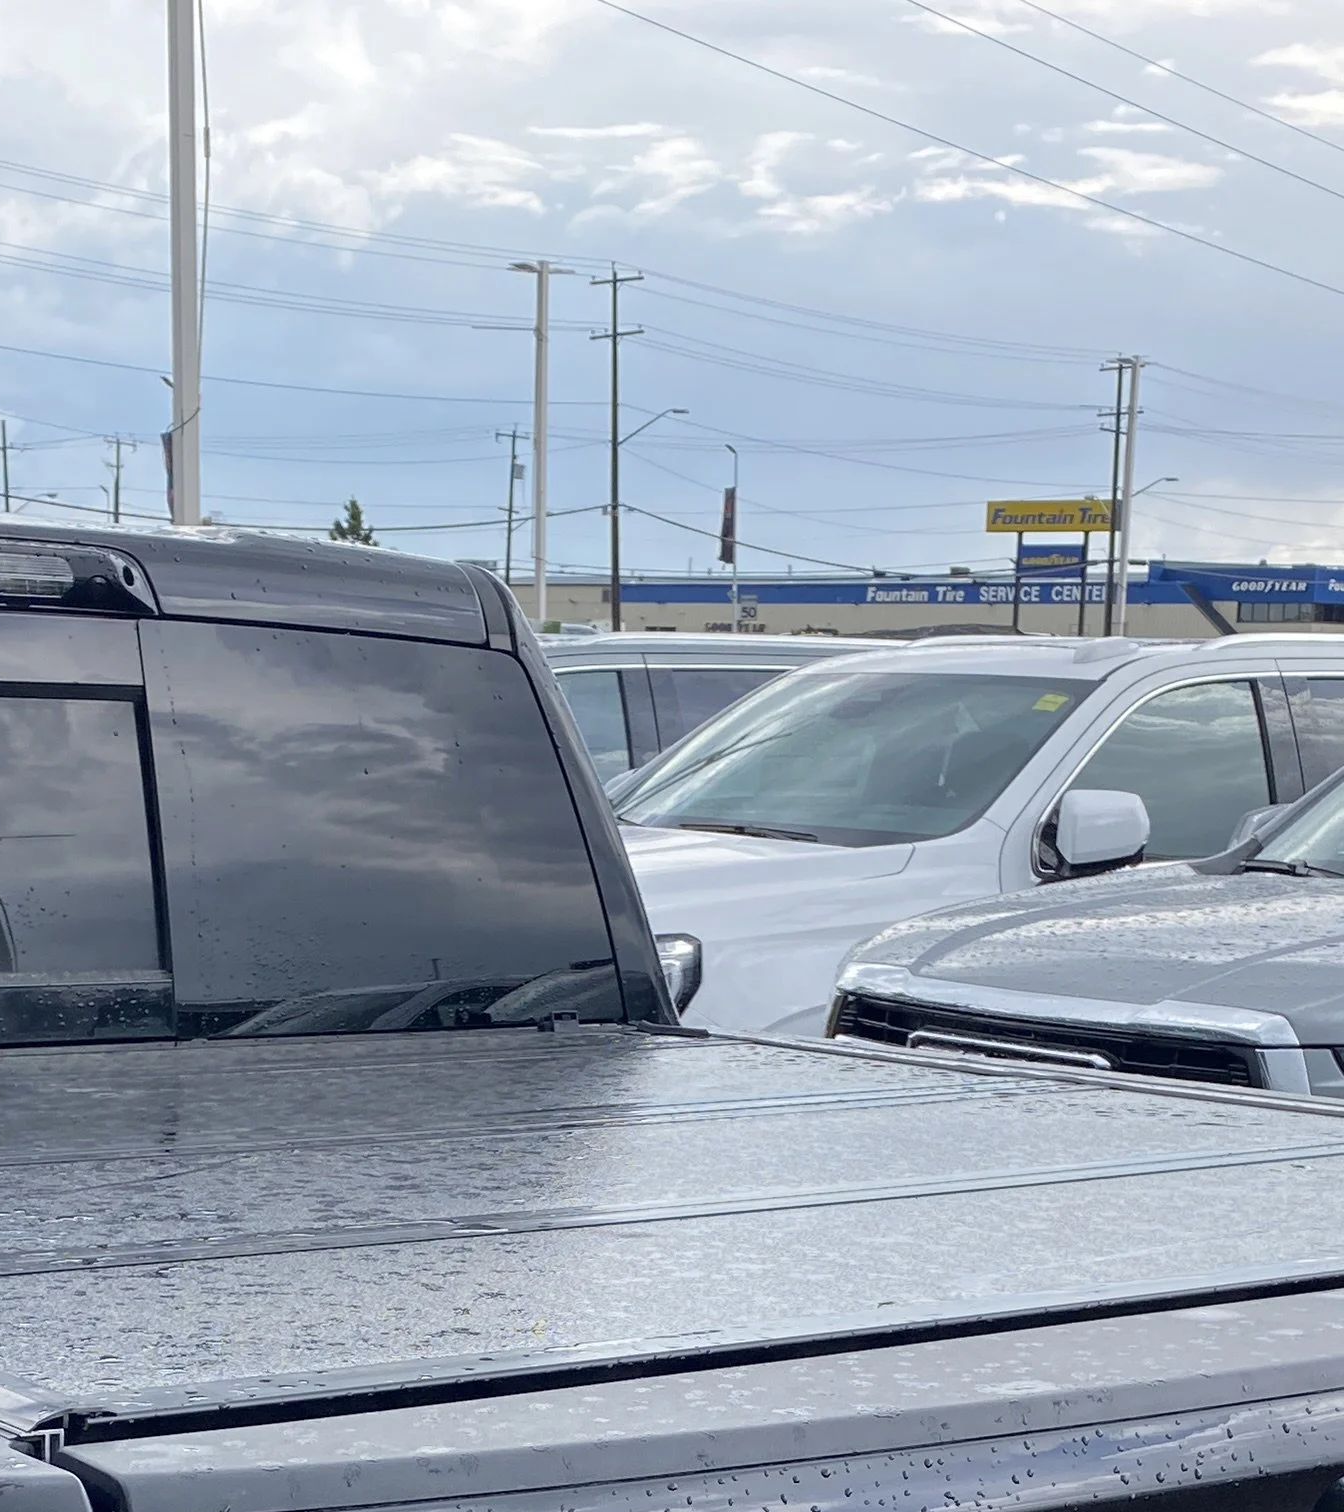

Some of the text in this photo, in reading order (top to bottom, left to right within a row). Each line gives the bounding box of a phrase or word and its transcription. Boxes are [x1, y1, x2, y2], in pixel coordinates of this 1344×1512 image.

[991, 507, 1074, 525] Fountain
[866, 586, 929, 602] Fountain
[935, 586, 965, 602] Tire
[979, 585, 1040, 602] SERVCE
[1231, 581, 1307, 593] GOODYEAR
[741, 606, 757, 618] 50
